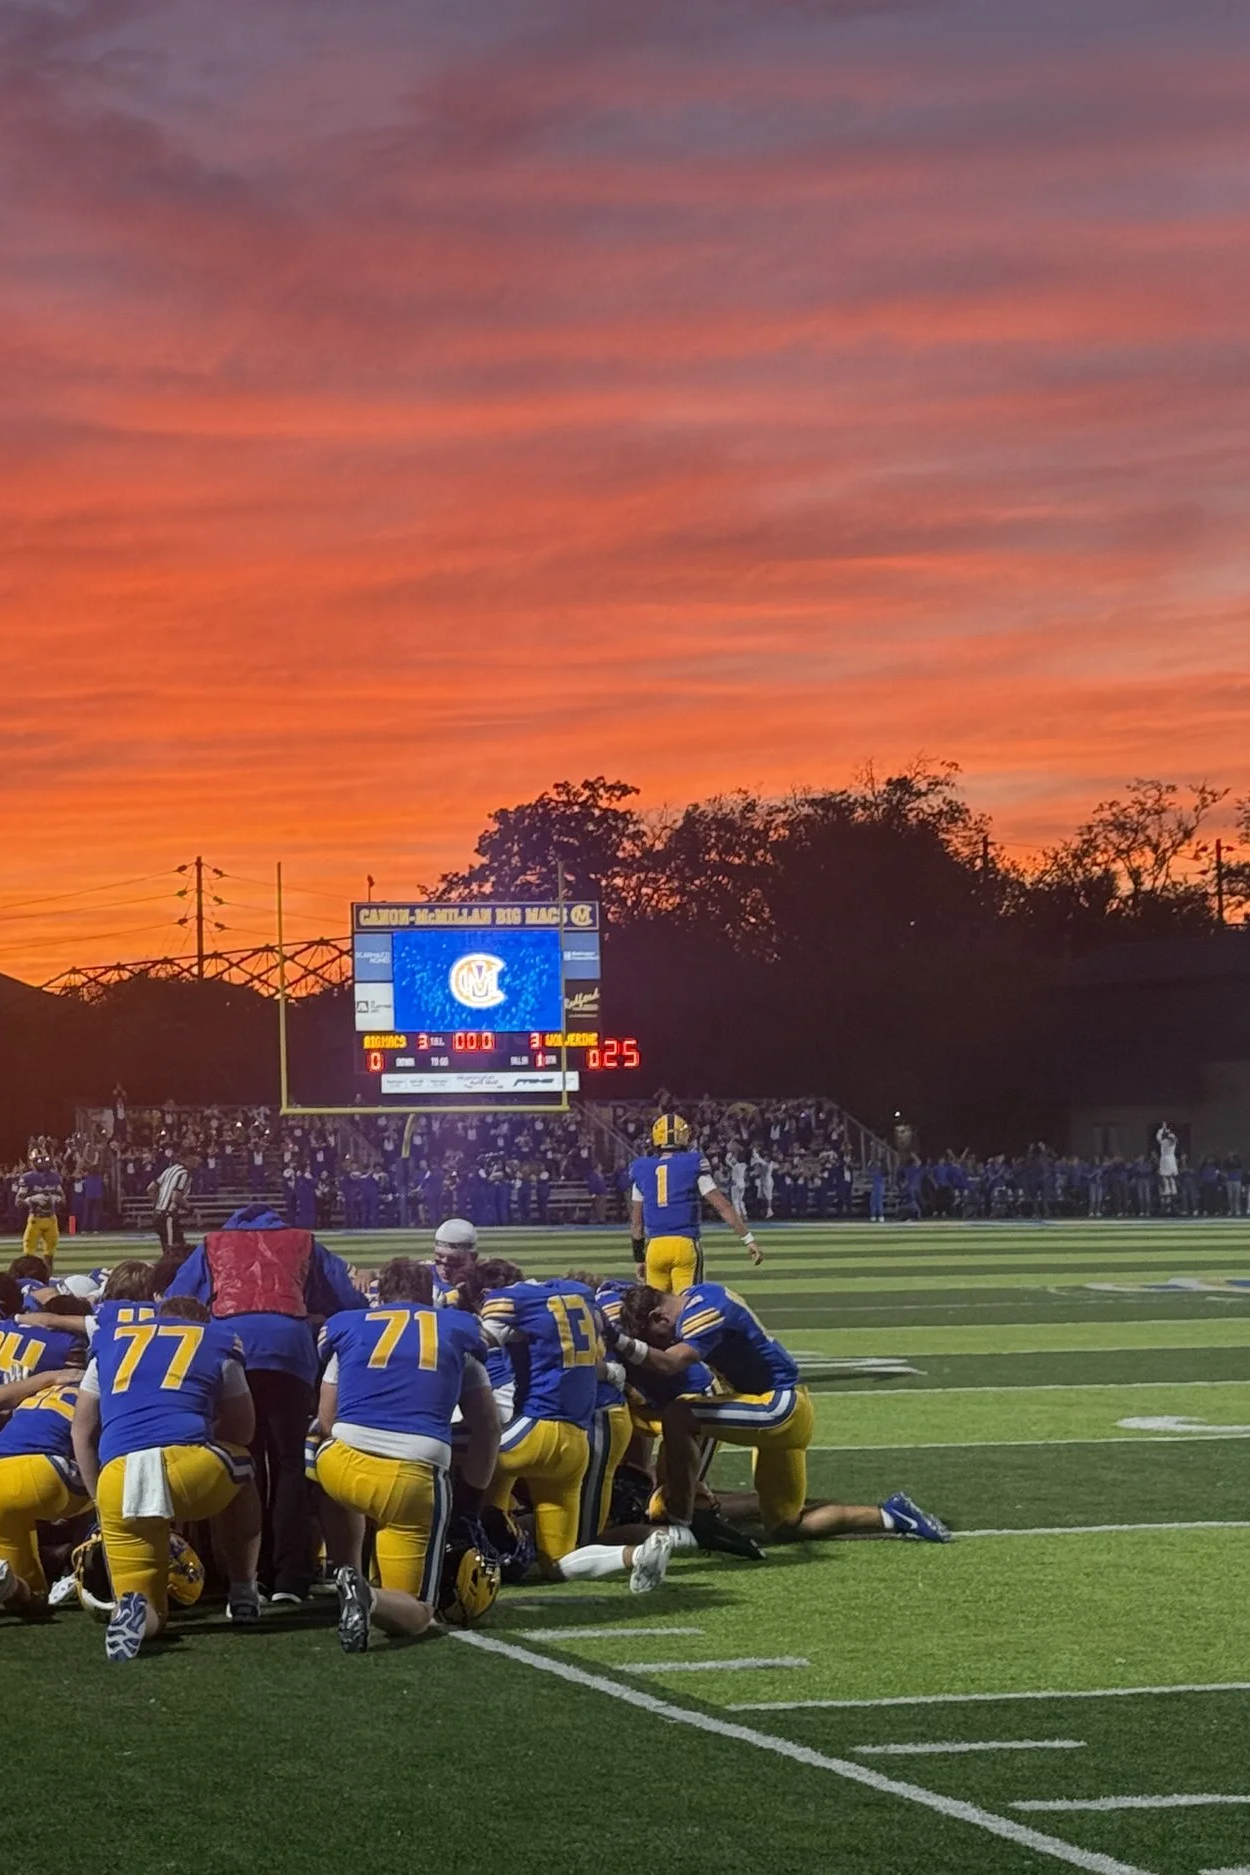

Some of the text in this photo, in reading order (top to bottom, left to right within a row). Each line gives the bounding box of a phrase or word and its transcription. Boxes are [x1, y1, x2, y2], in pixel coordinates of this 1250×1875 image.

[359, 908, 491, 926] CANON-McMILLAN
[495, 908, 521, 926] BIG
[418, 1033, 429, 1050] 3
[530, 1033, 540, 1049] 3
[369, 1052, 381, 1070] 0
[589, 1049, 600, 1067] 0
[603, 1040, 638, 1067] 25
[655, 1165, 668, 1208] 1
[365, 1309, 438, 1371] 71
[547, 1294, 598, 1369] 13
[111, 1324, 205, 1394] 77
